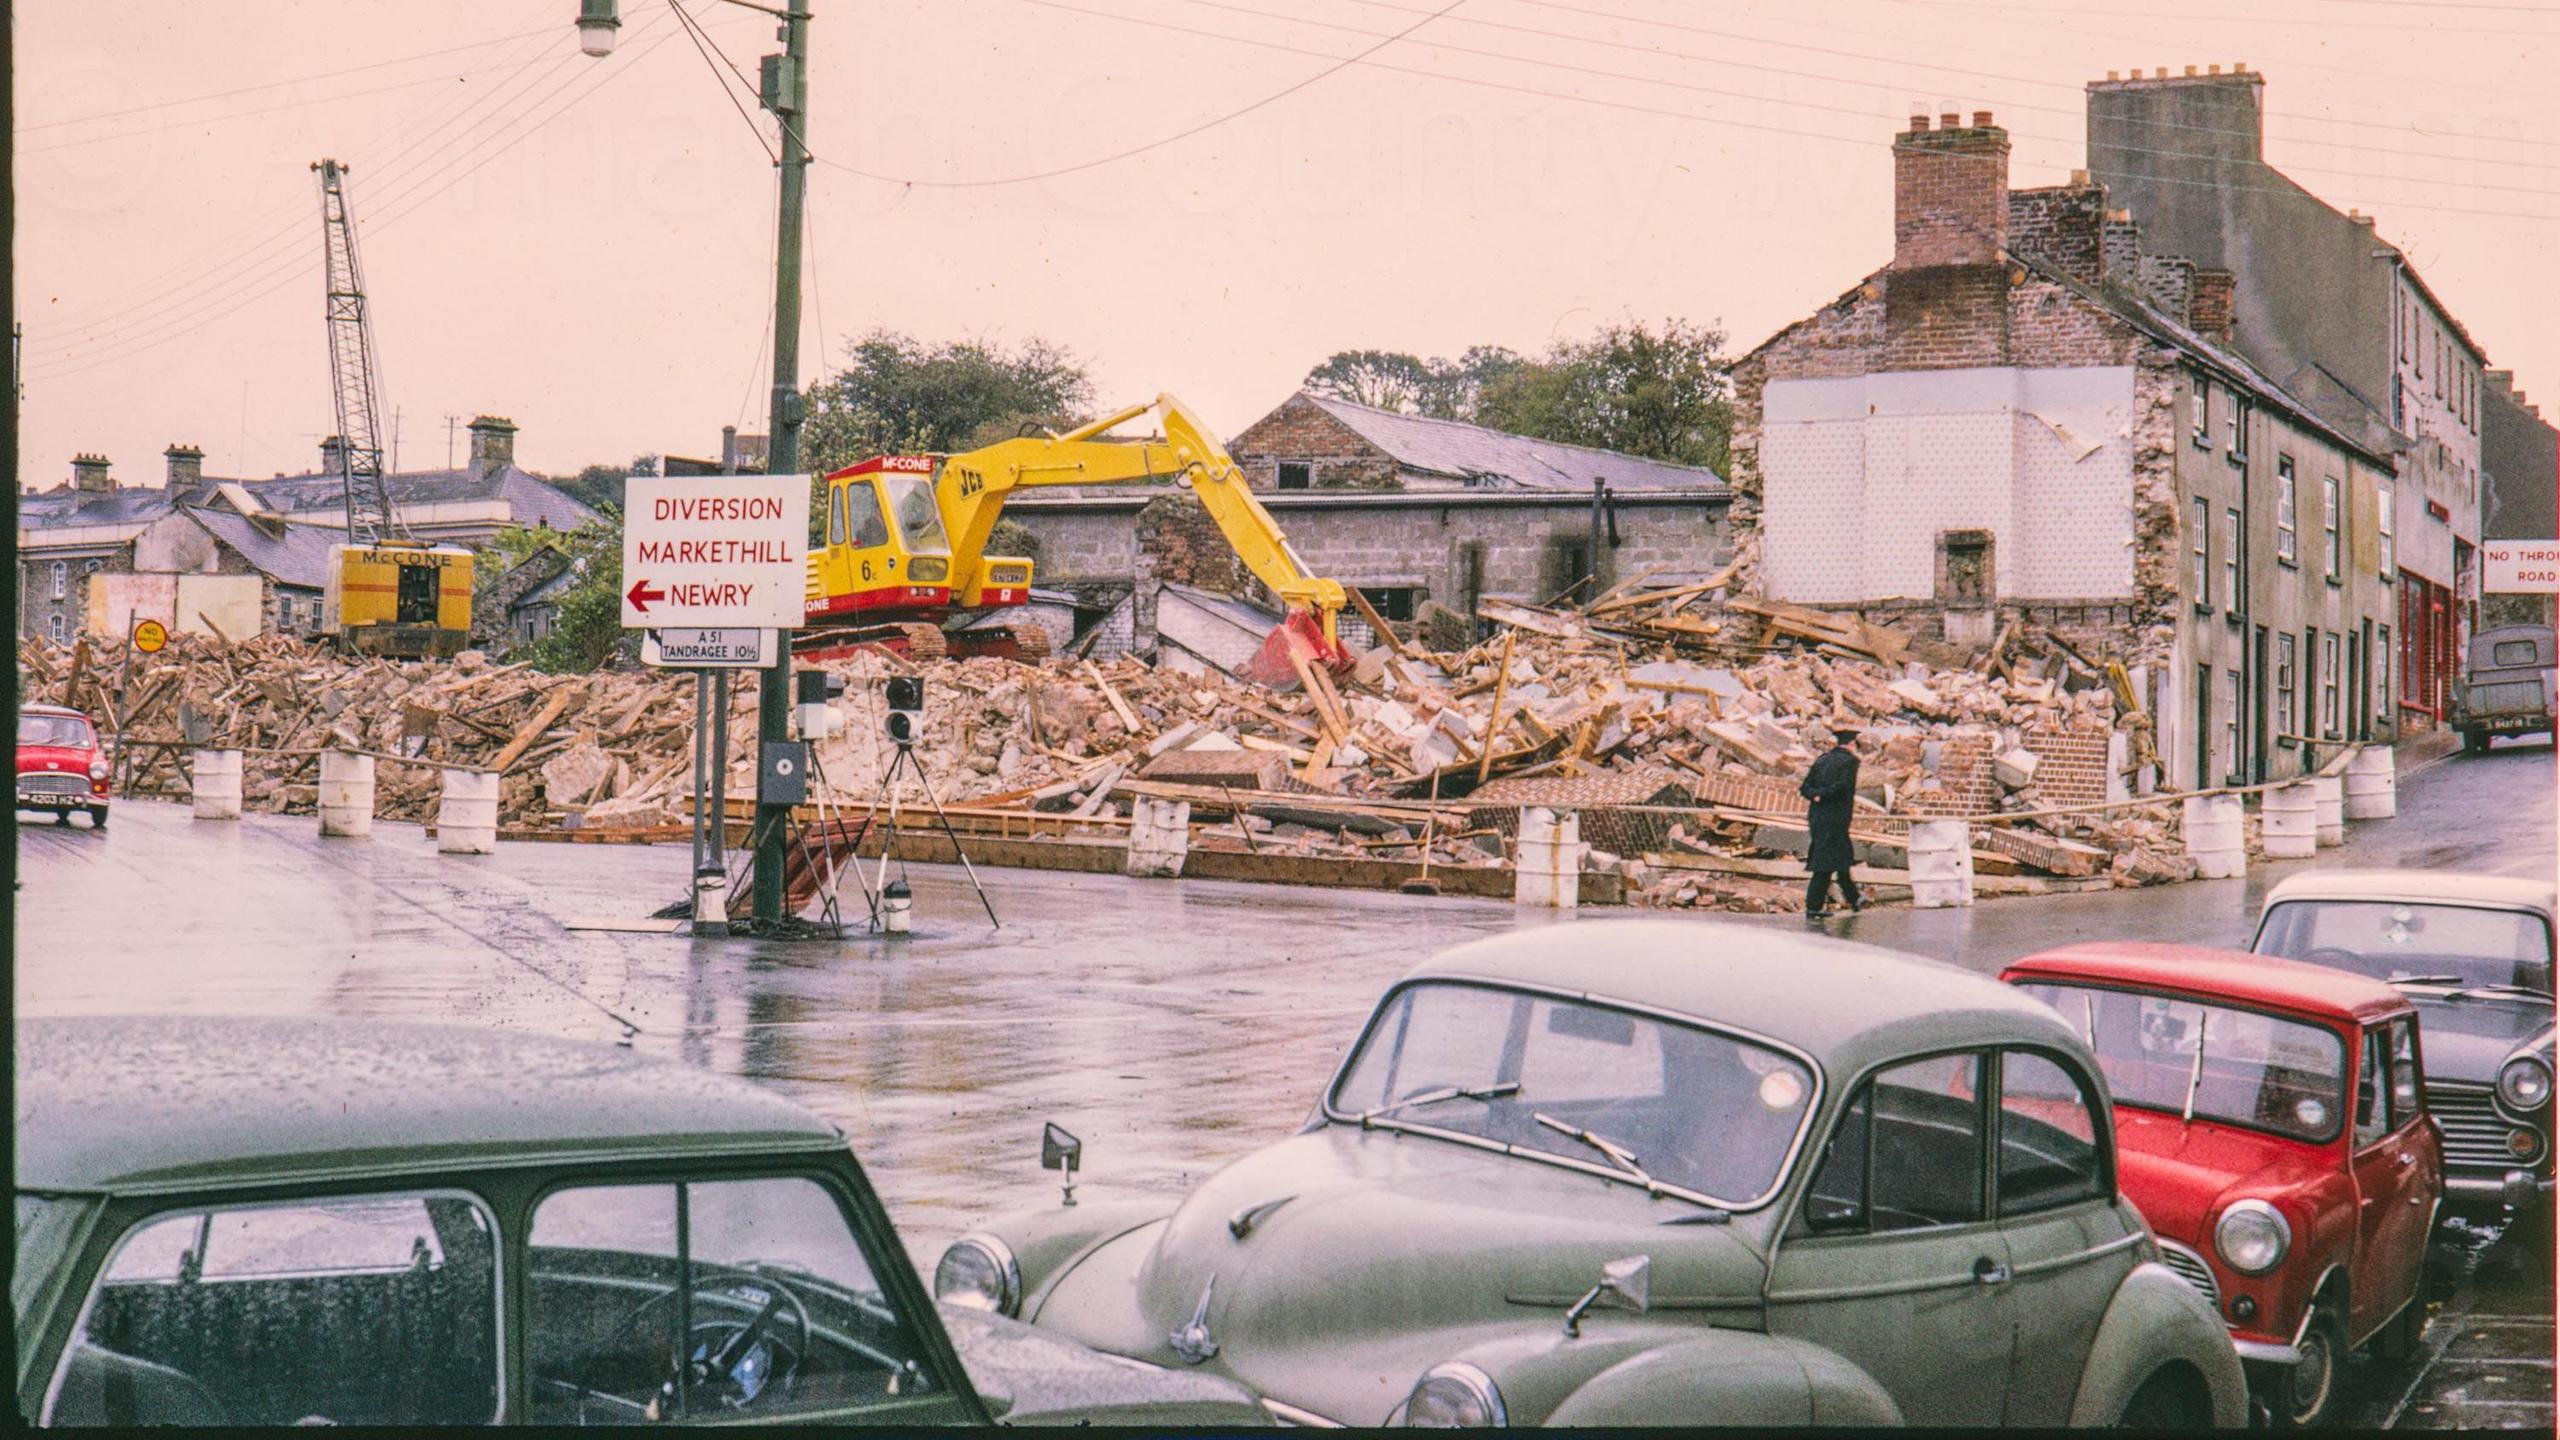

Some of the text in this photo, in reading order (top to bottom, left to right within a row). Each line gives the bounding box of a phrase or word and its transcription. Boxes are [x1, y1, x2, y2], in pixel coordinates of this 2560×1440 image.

[881, 456, 931, 471] McCONE
[961, 468, 984, 497] JCB
[655, 497, 783, 520] DIVERSION
[362, 551, 452, 567] McCONE
[639, 541, 793, 563] MARKETHILL
[2489, 551, 2510, 561] NO
[2518, 571, 2556, 581] ROAD
[671, 584, 754, 606] NEWRY
[805, 598, 830, 612] ONE
[144, 627, 158, 636] NO
[663, 645, 728, 657] TANDRAGEE
